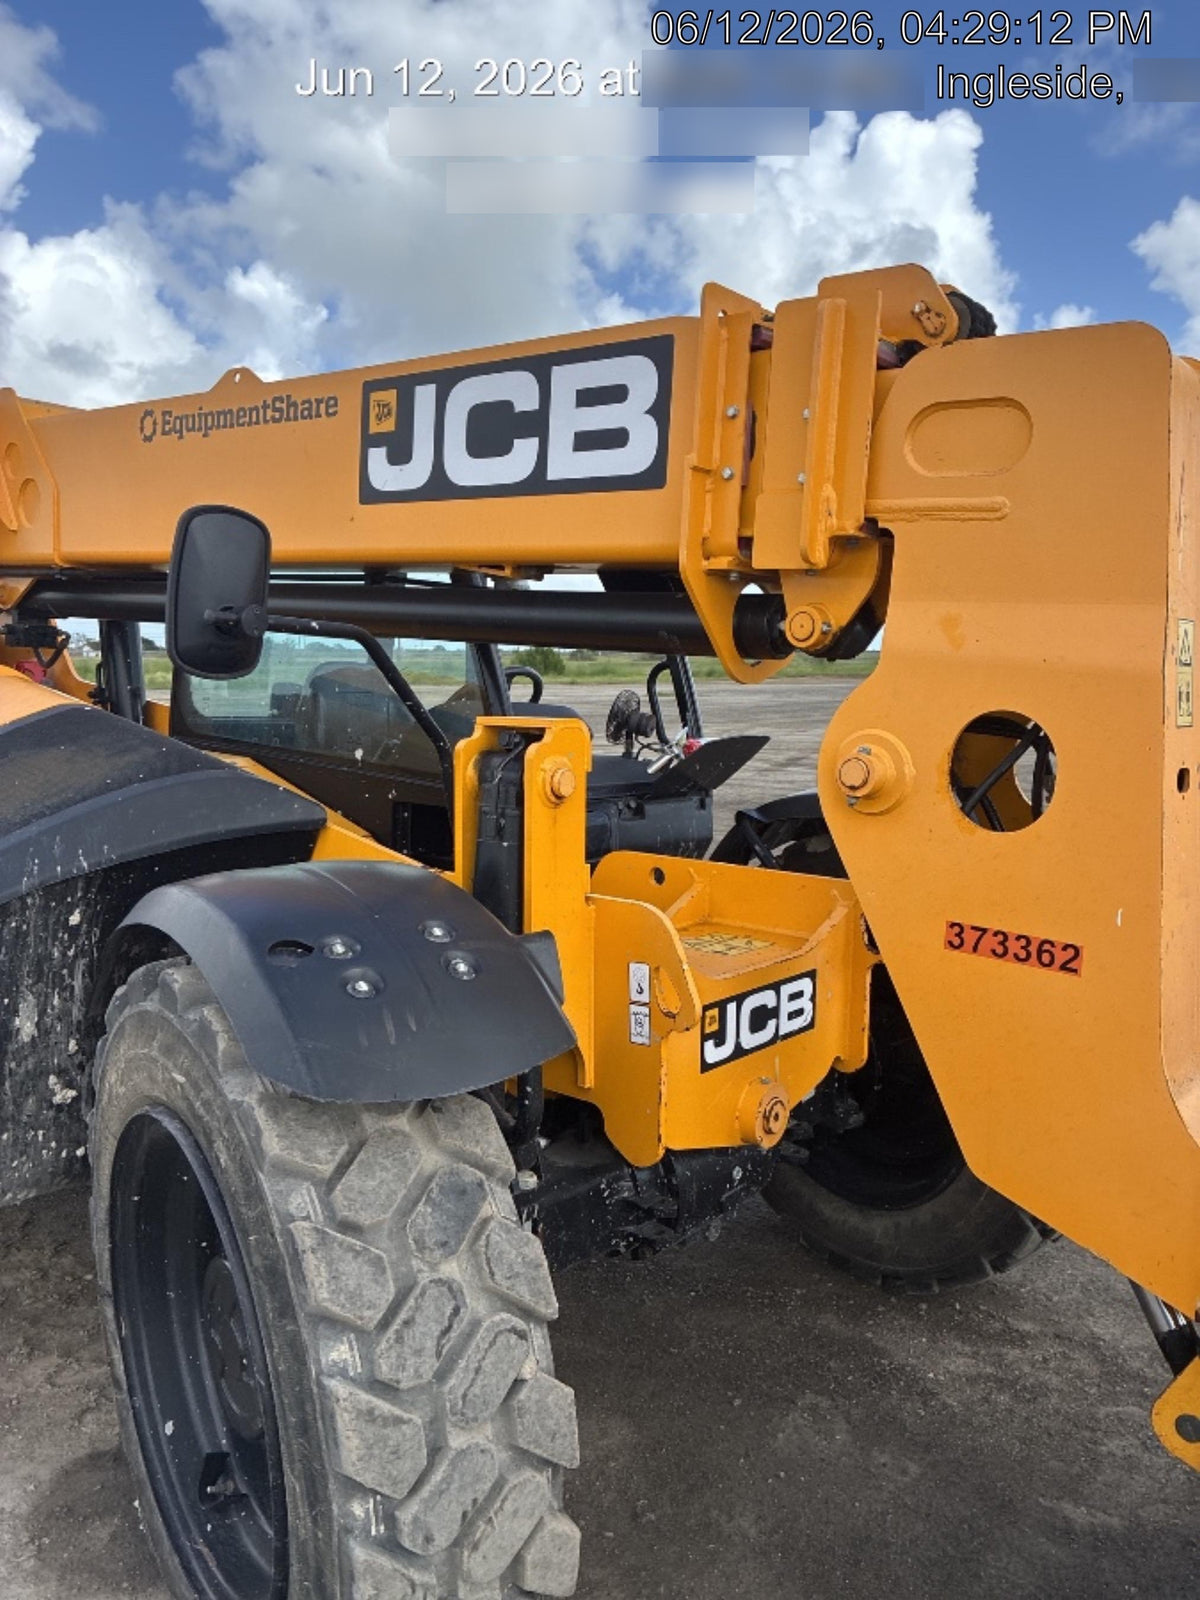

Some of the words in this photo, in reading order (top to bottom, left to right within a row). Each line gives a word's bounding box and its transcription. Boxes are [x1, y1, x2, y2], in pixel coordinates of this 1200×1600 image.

[161, 394, 339, 441] EquipmentShare
[367, 354, 659, 491] JCB
[947, 921, 1081, 975] 373362
[703, 977, 813, 1064] JCB
